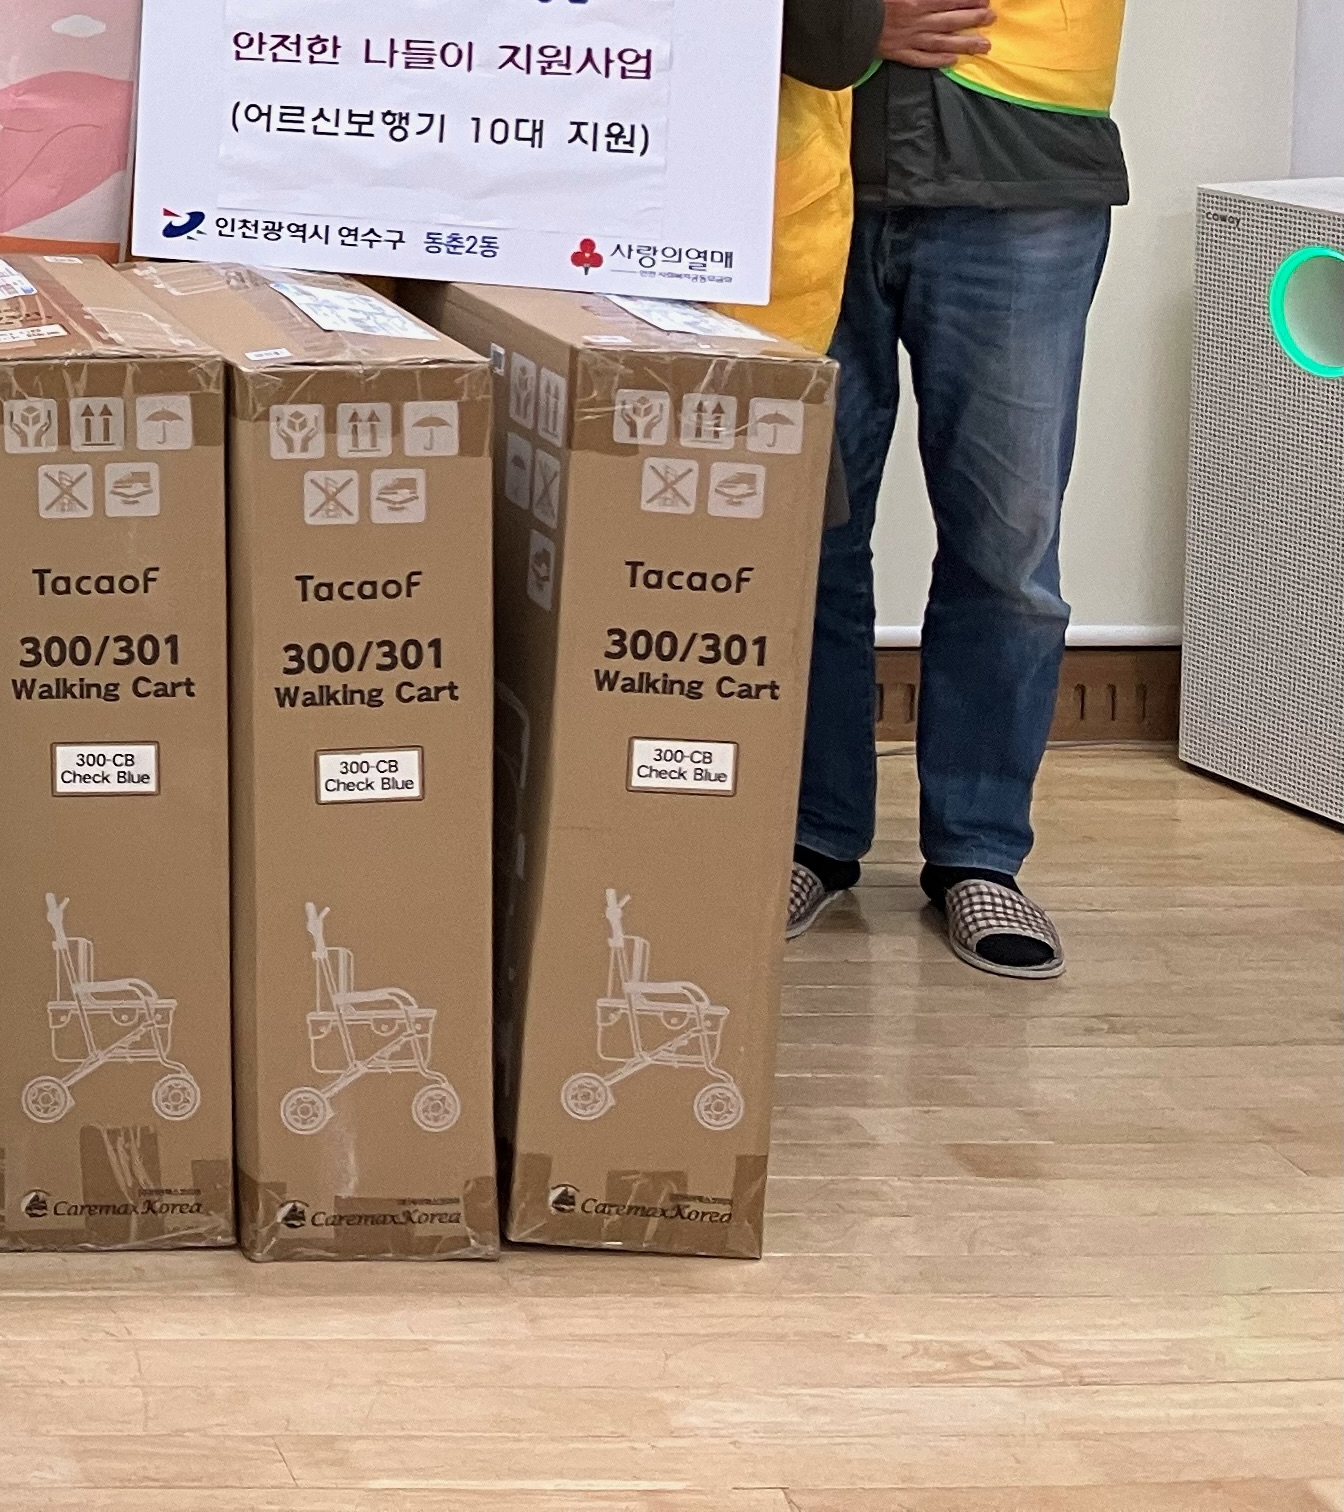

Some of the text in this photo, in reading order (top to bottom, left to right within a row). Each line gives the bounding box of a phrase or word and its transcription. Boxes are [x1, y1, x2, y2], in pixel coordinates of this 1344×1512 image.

[232, 30, 653, 80] 안전한 나들이 지원사업
[230, 100, 651, 156] (어르신보행기 10대 지원)
[215, 217, 500, 258] 인천광역시 연수구 동춘2동
[610, 244, 734, 271] 사랑의열매
[19, 633, 179, 668] 300/301
[282, 637, 442, 676] 300/301
[603, 627, 767, 667] 300/301
[11, 675, 196, 702] Walking Cart
[274, 681, 459, 708] Walking Cart
[594, 668, 780, 701] Walking Cart
[75, 752, 135, 768] 300-CB
[339, 758, 399, 775] 300-CB
[653, 748, 713, 765] 300-CB
[60, 769, 150, 785] Check Blue
[324, 774, 414, 793] Check Blue
[636, 765, 728, 784] Check Blue
